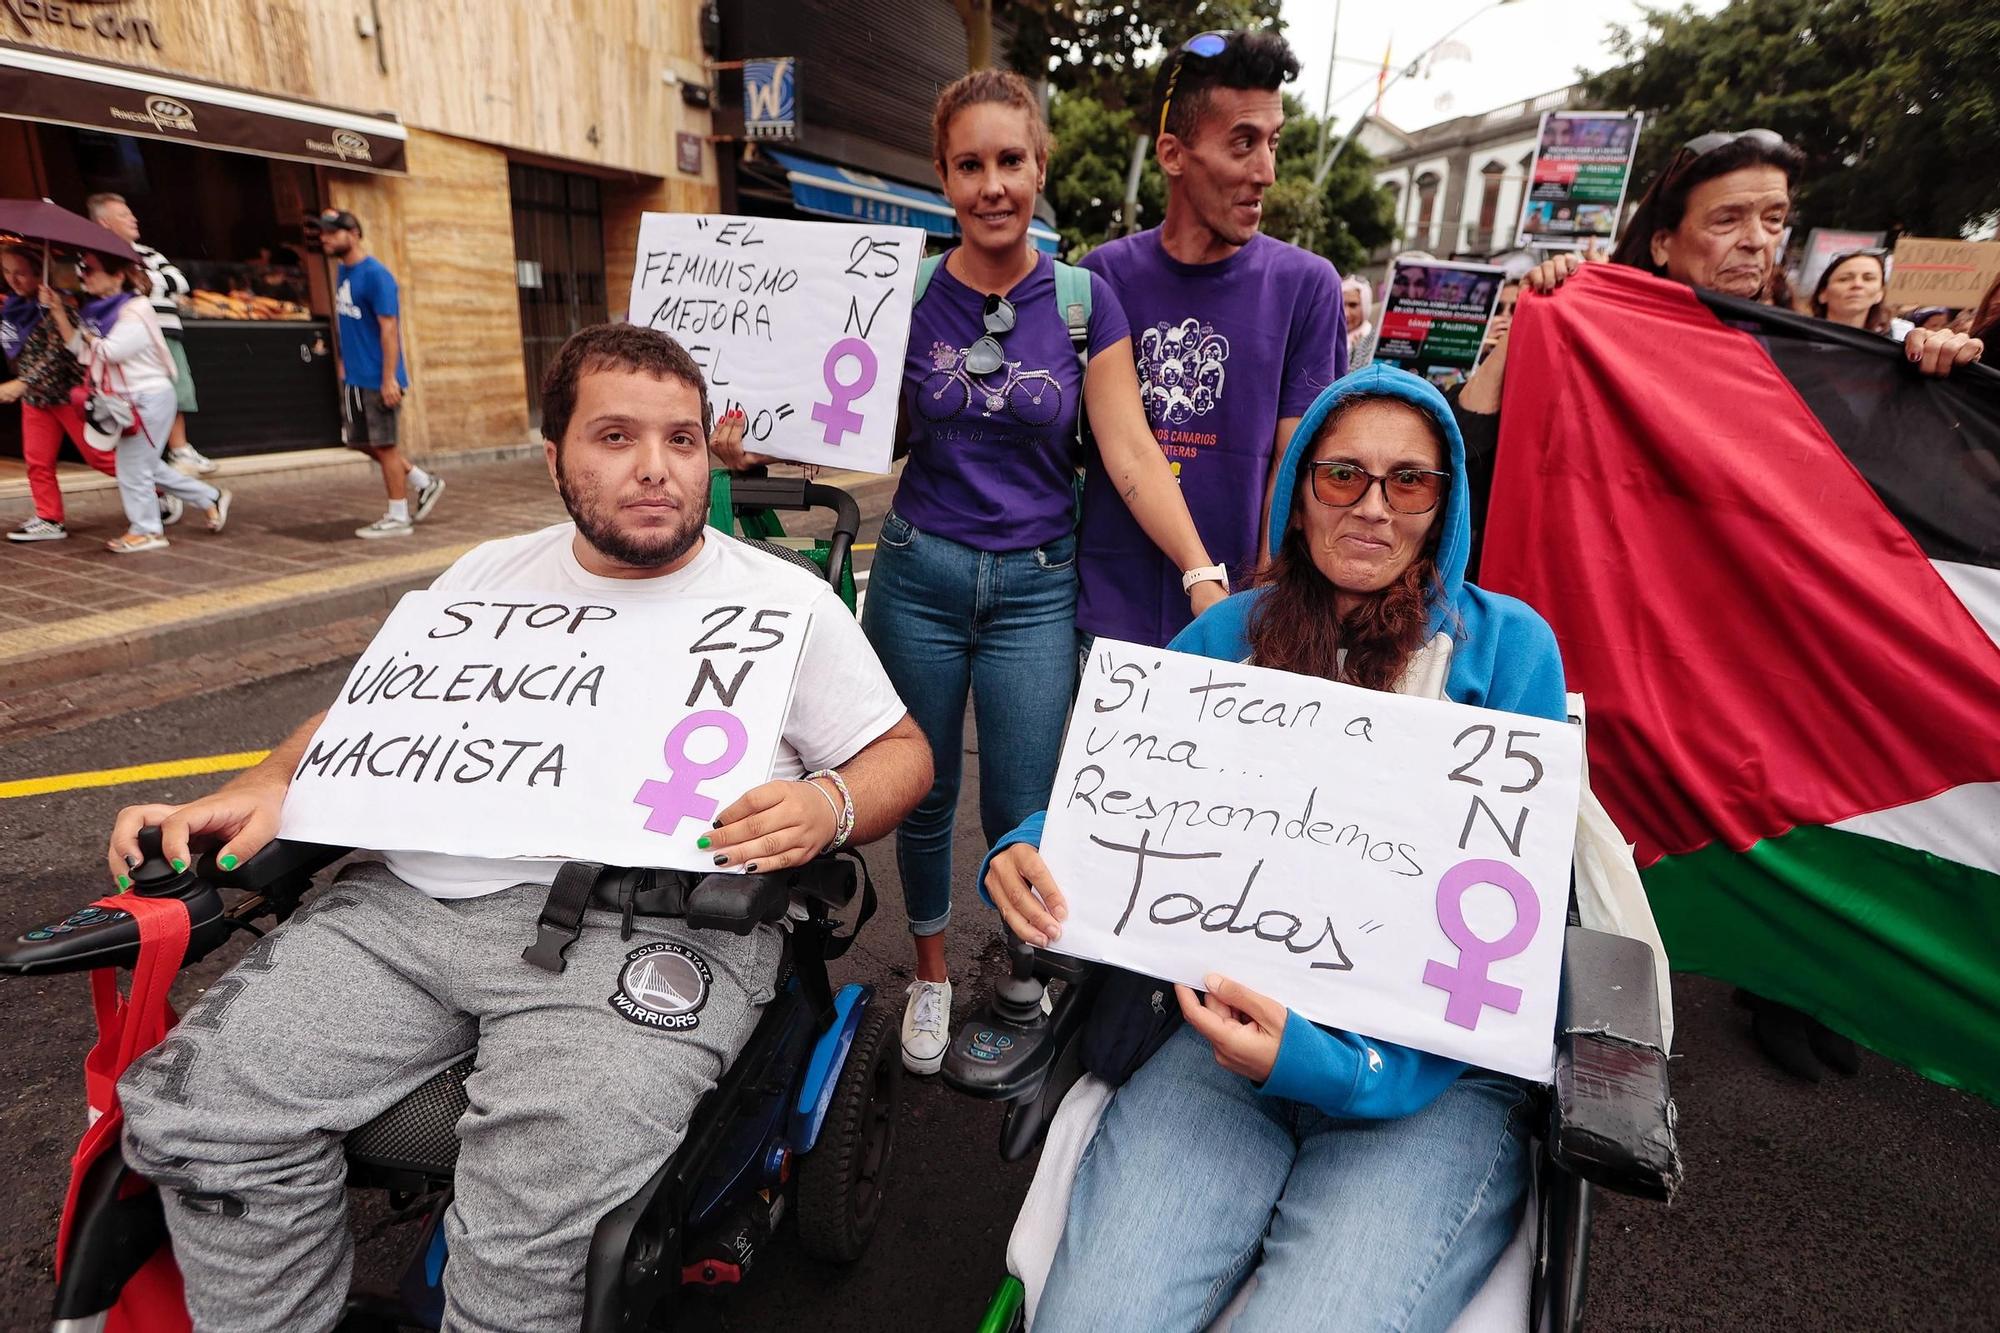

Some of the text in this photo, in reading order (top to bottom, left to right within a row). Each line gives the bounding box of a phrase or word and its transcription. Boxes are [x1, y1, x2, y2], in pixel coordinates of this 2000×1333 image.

[641, 251, 799, 297] FEMINISMO
[845, 235, 900, 278] 25
[650, 296, 772, 342] MEJORA
[843, 287, 895, 339] N
[1170, 430, 1217, 446] CANARIOS
[427, 601, 618, 641] STOP
[688, 605, 792, 654] 25
[684, 658, 755, 708] N
[1344, 716, 1375, 743] a
[1447, 723, 1544, 794] 25
[1067, 764, 1425, 877] Respondemos
[1458, 794, 1530, 858] N
[629, 944, 712, 981] GOLDEN STATE
[612, 992, 698, 1028] WARRIORS
